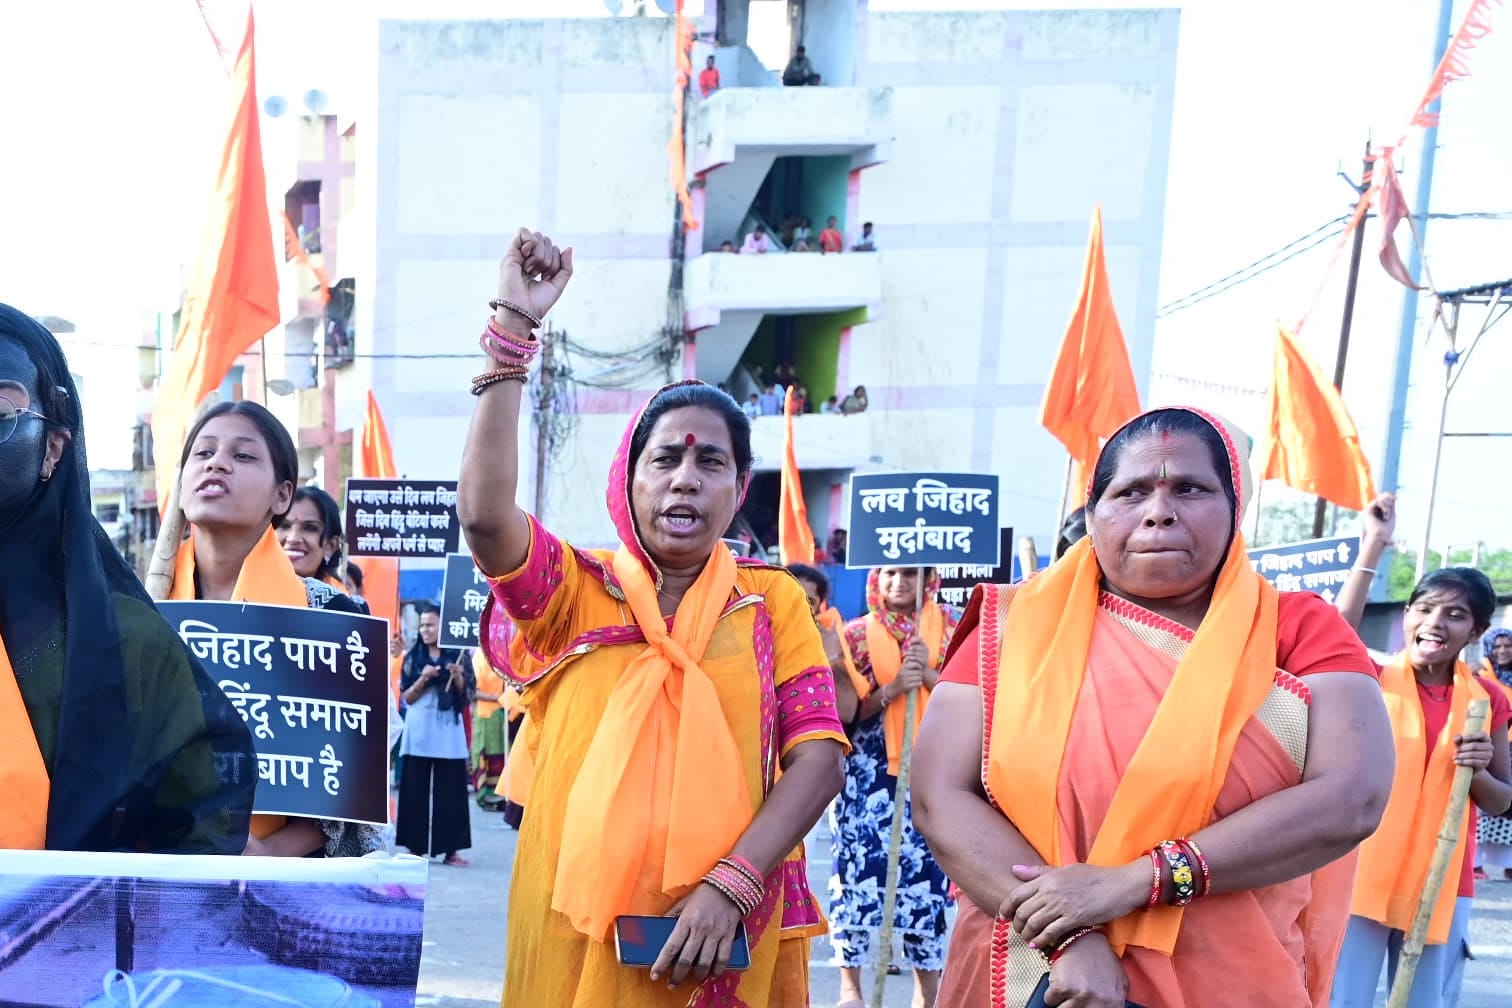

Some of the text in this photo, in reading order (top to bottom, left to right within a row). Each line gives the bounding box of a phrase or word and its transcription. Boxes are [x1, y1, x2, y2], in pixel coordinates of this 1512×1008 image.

[404, 485, 420, 507] दिन
[420, 490, 435, 505] लव
[436, 485, 457, 507] जिहा
[859, 478, 992, 515] लव जिहाद
[355, 508, 375, 528] जिस
[375, 508, 390, 530] दिन
[390, 508, 406, 534] हिंदू
[417, 533, 427, 552] से
[875, 518, 974, 559] मुर्दाबाद
[1260, 552, 1304, 573] जिहाद
[1305, 548, 1337, 566] पाप
[1336, 541, 1351, 564] है
[448, 616, 471, 639] को
[280, 636, 342, 674] पाप
[345, 630, 370, 682] है
[277, 695, 372, 737] समाज
[256, 752, 314, 788] बाप
[318, 743, 344, 796] है
